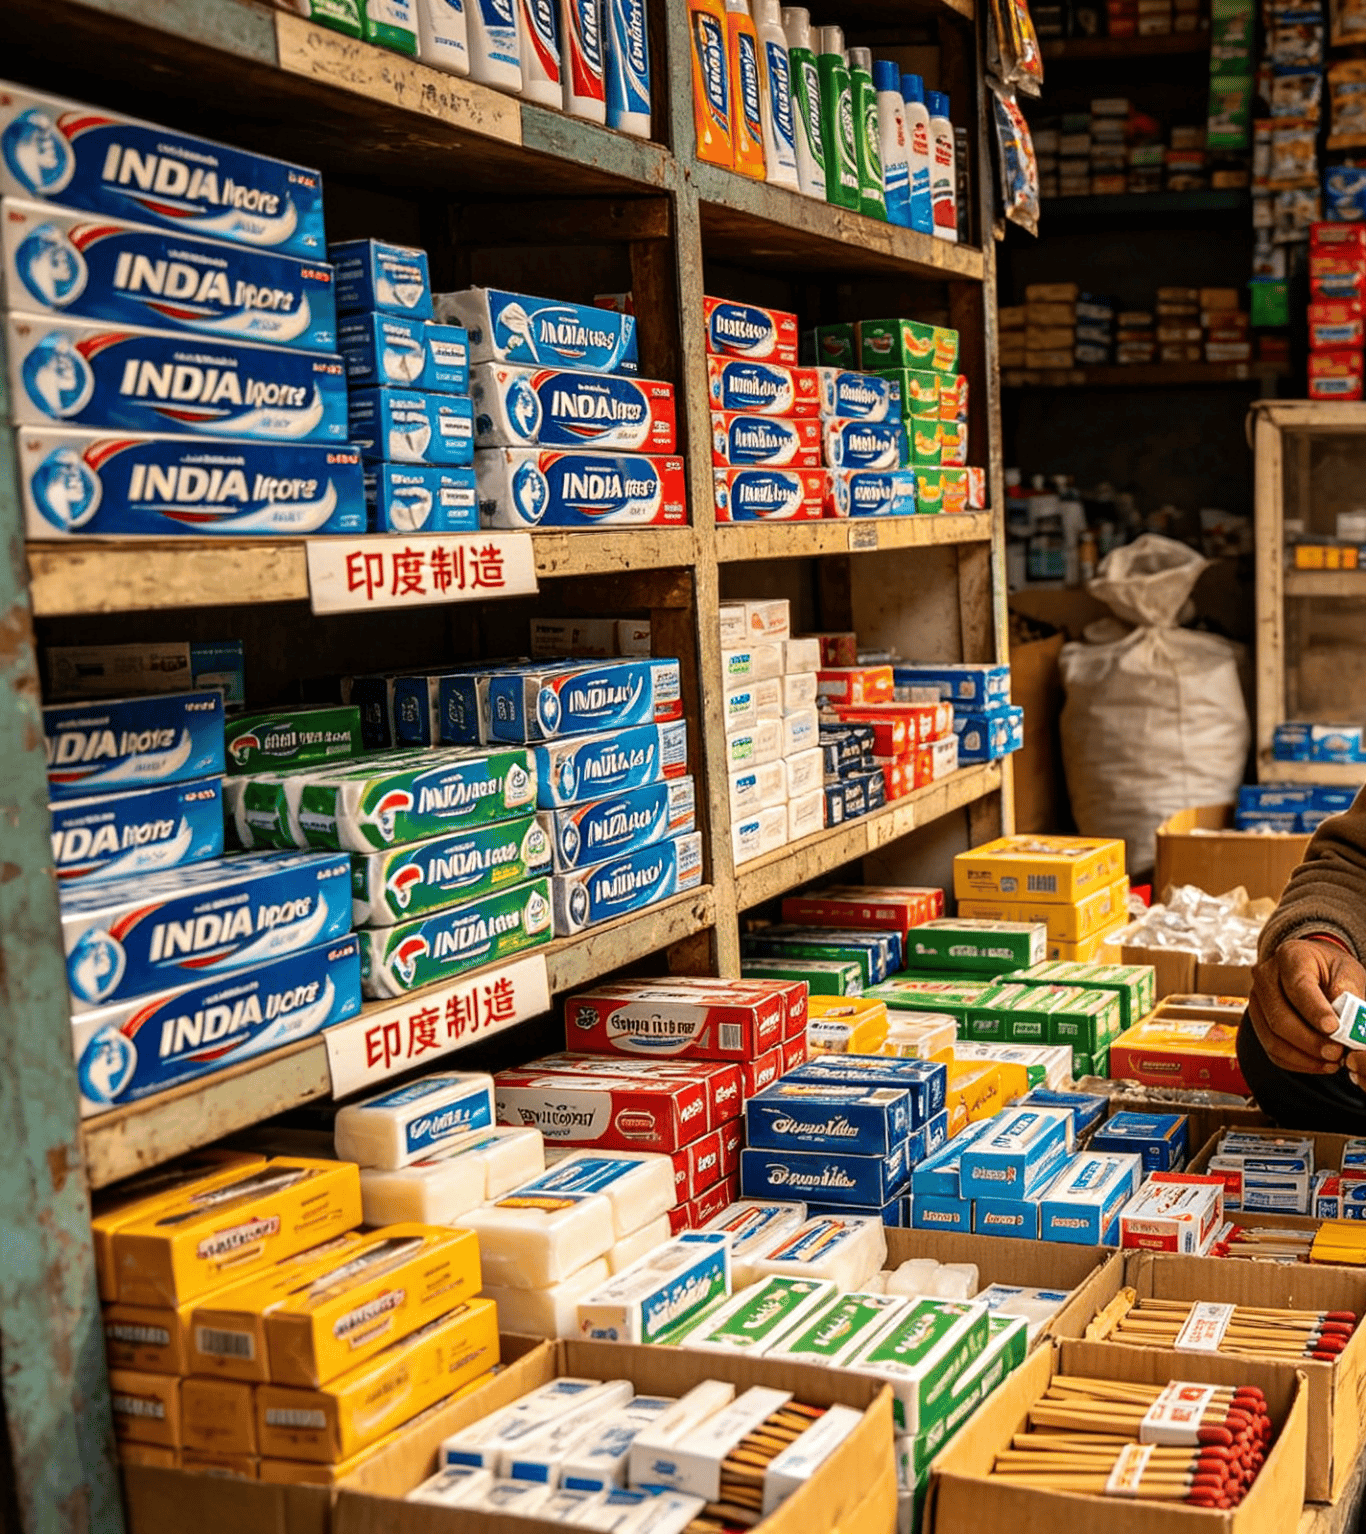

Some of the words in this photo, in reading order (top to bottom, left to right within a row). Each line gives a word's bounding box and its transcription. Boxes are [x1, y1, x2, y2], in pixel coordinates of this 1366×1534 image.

[102, 143, 220, 206] INDIA
[120, 359, 243, 406] INDIA
[128, 464, 249, 503] INDIA
[345, 543, 506, 601] 印度制造
[150, 906, 253, 962] INDIA
[159, 994, 264, 1058] INDIA
[364, 977, 516, 1069] 印度制造
